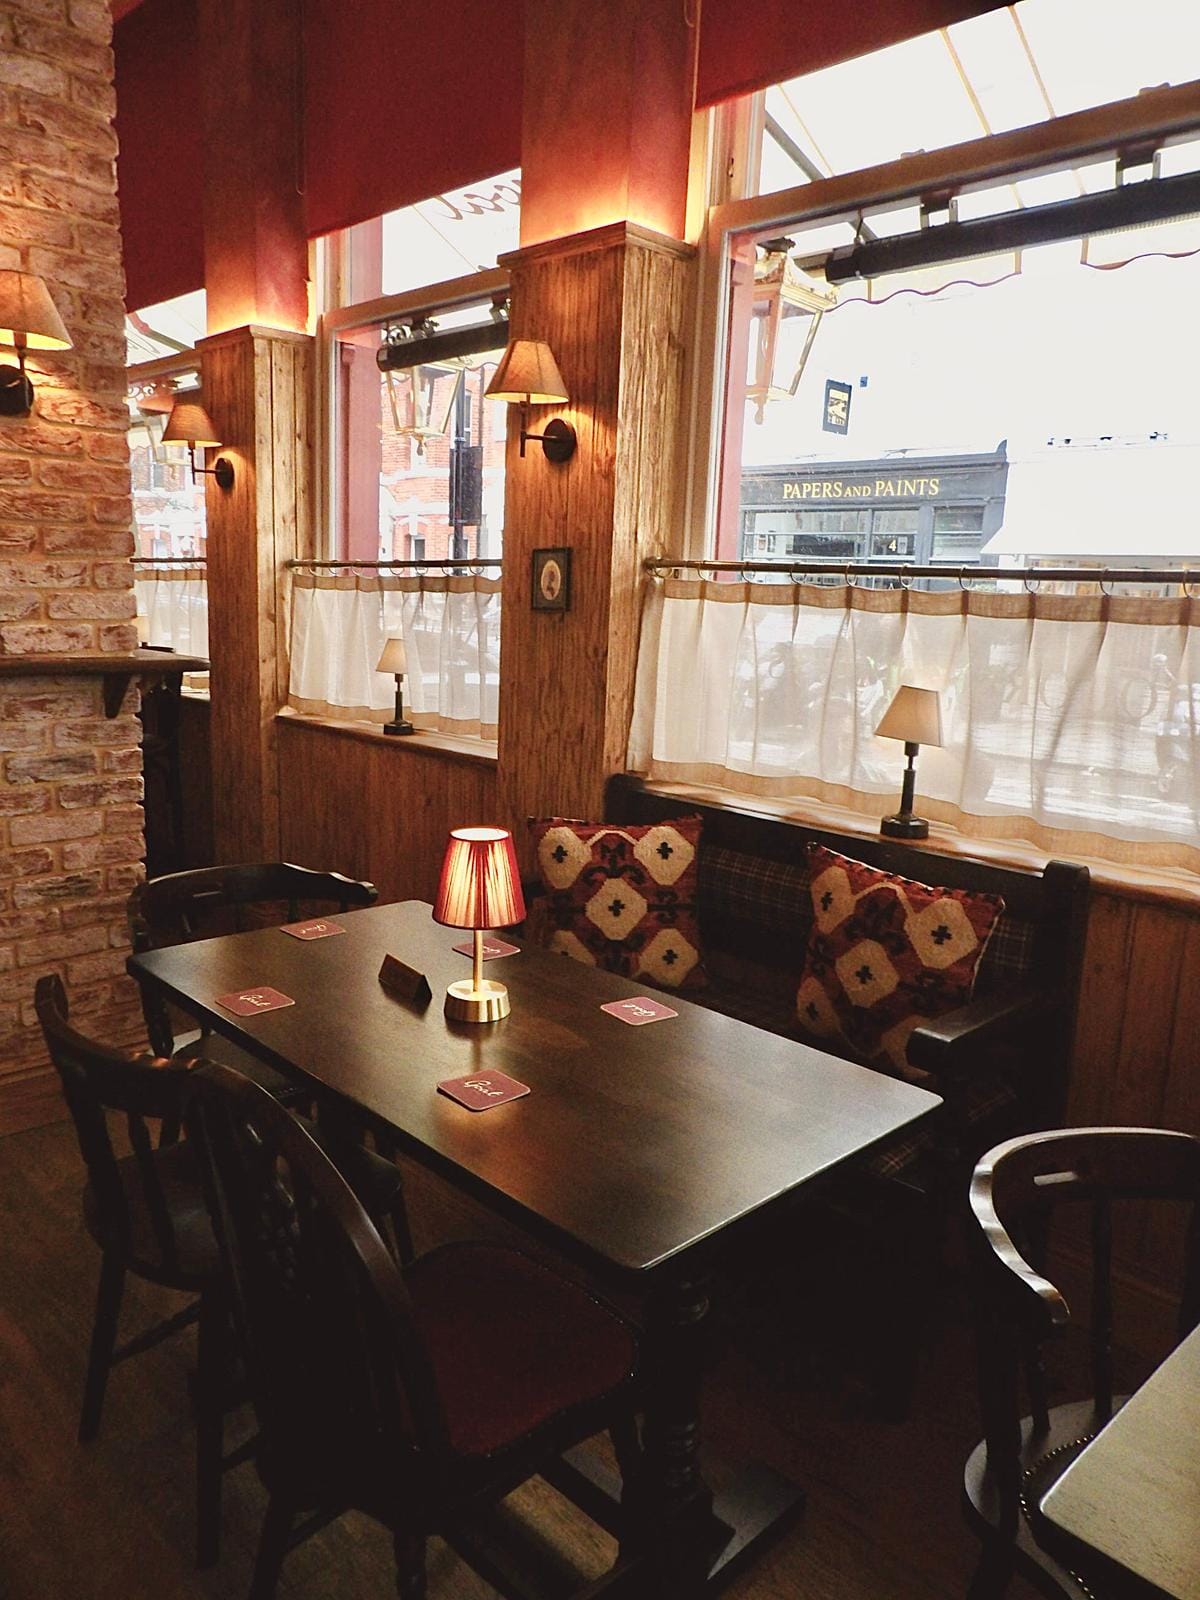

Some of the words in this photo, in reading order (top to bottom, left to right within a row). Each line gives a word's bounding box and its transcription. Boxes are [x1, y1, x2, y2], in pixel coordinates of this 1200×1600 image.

[783, 481, 843, 499] PAPERS
[844, 485, 872, 498] AND
[875, 478, 940, 497] PAINTS
[888, 539, 897, 552] 4
[463, 1079, 504, 1097] Goat
